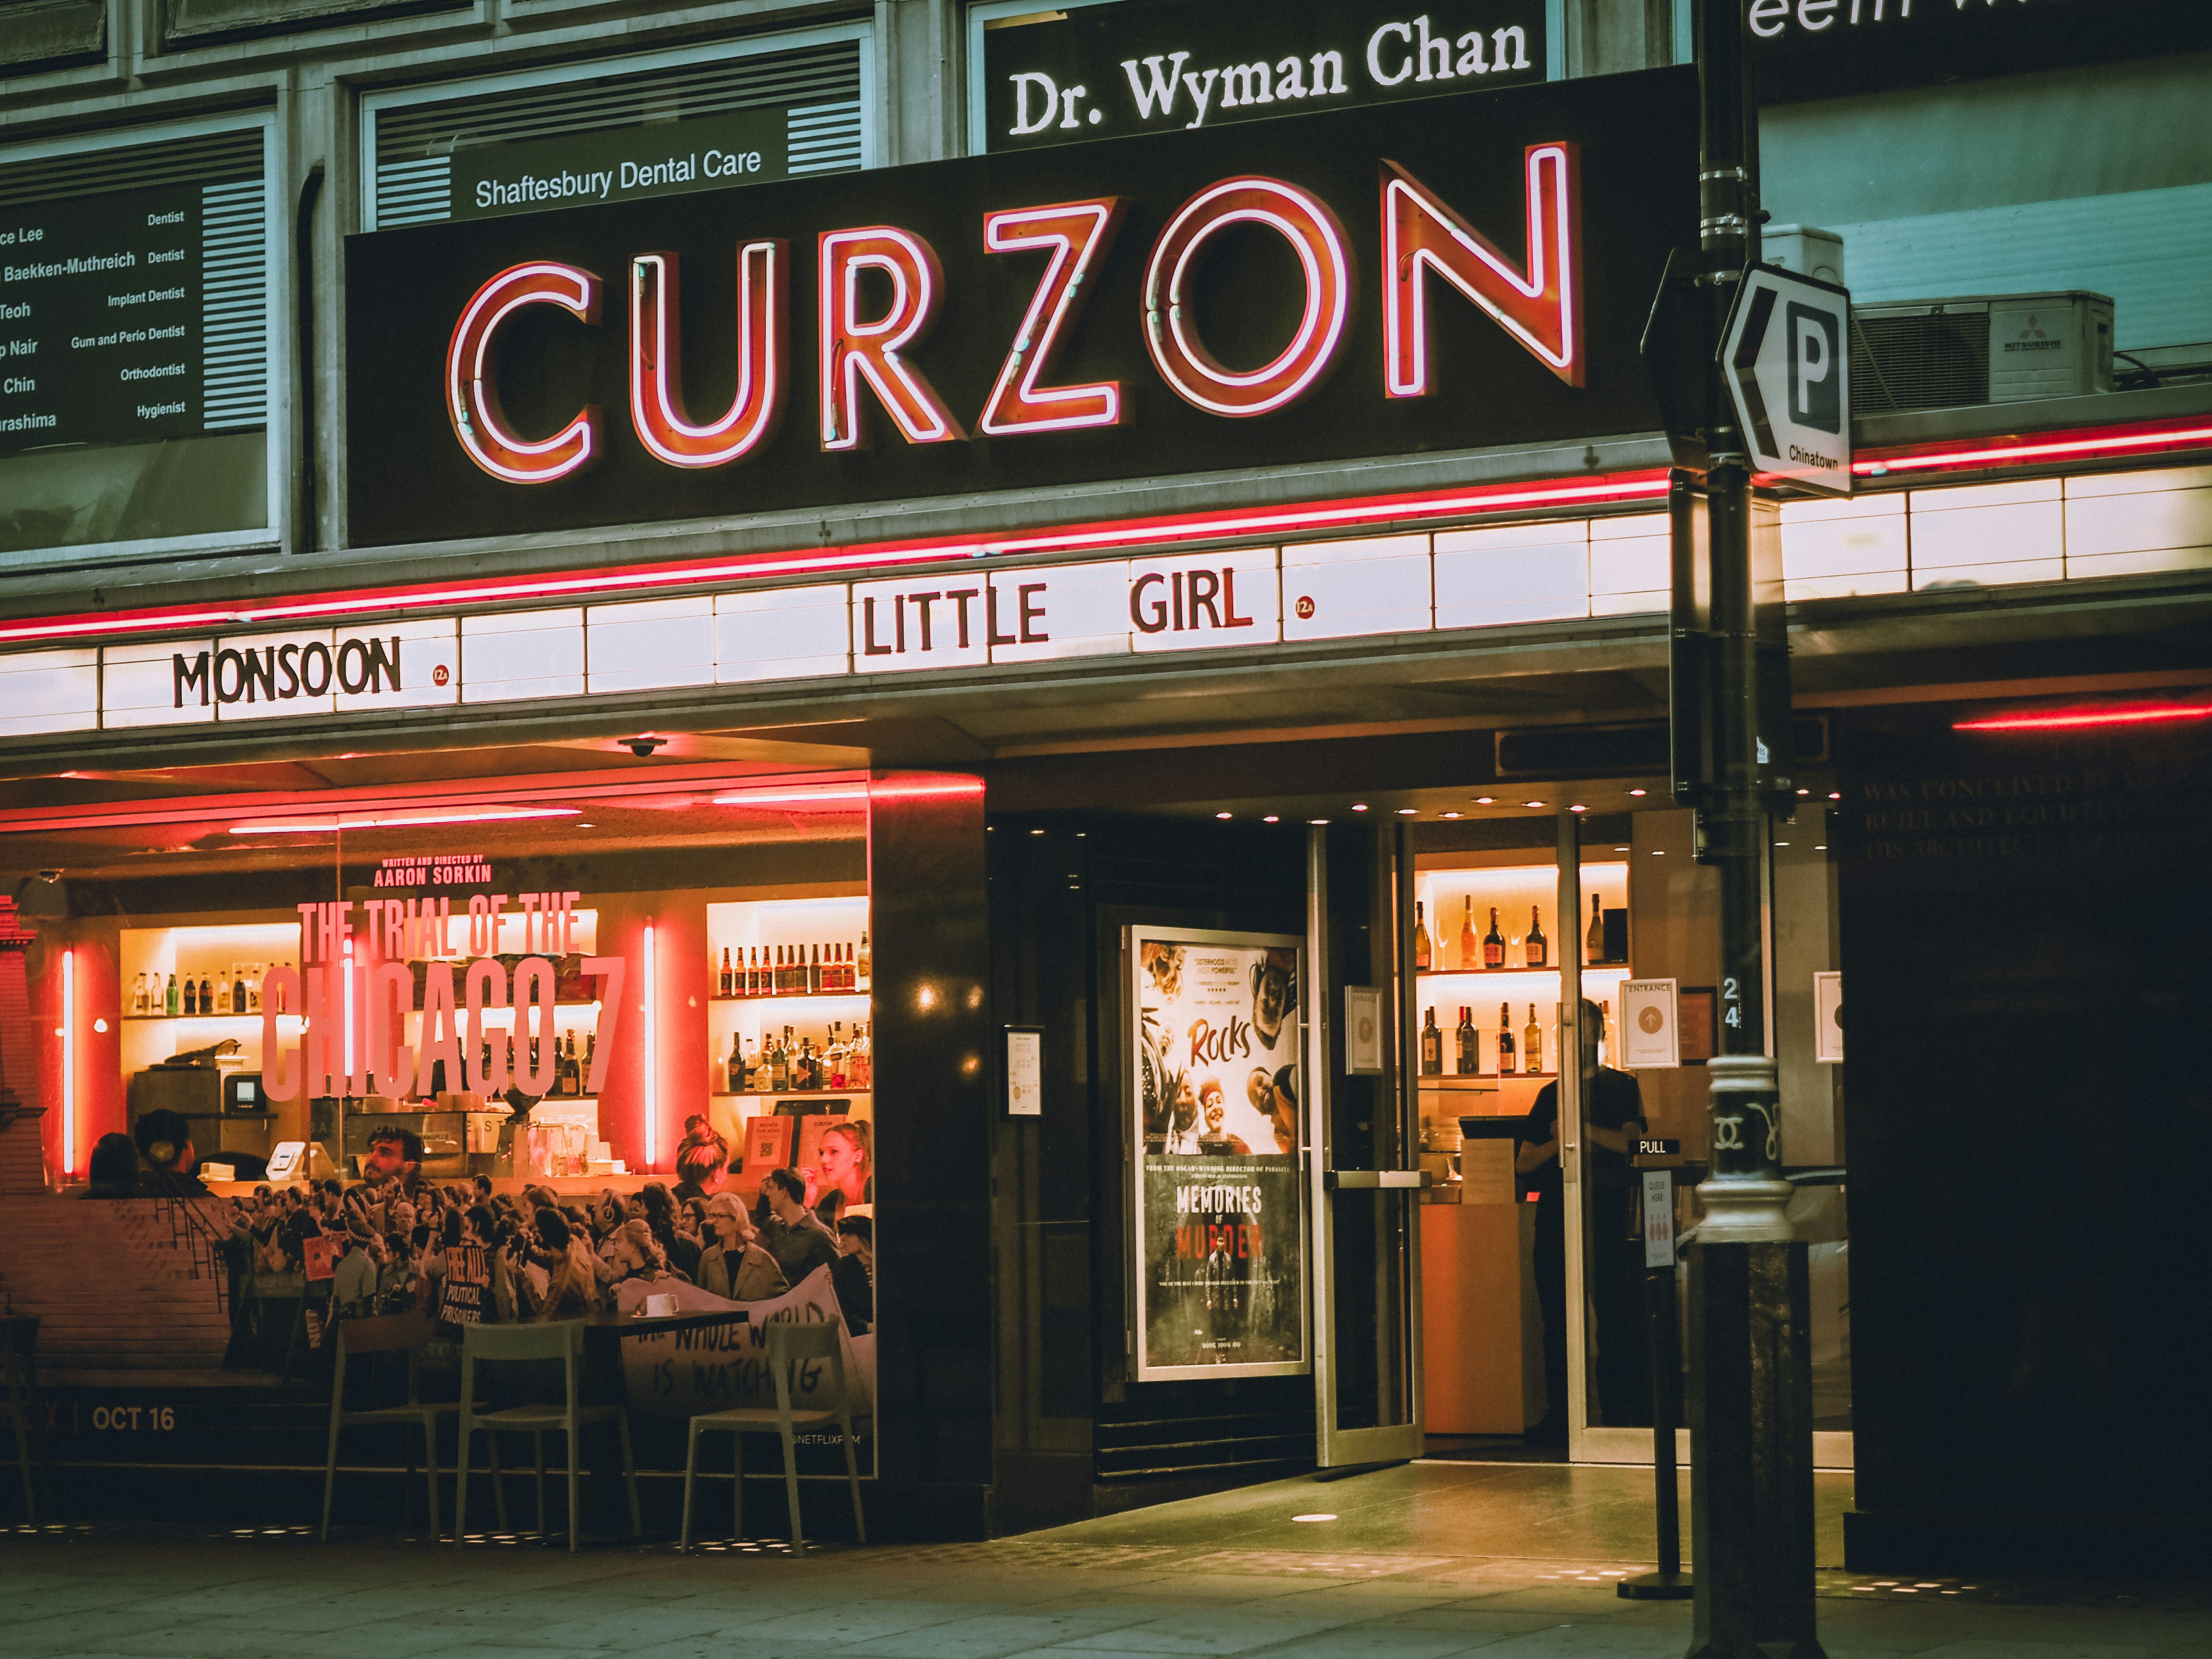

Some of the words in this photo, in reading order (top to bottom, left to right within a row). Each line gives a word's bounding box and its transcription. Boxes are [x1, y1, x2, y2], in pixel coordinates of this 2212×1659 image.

[1009, 71, 1101, 135] Dr.
[1120, 49, 1347, 130] Wyman
[1366, 15, 1530, 86] Chan
[476, 169, 613, 207] Shaftesbury
[620, 153, 696, 189] Dental
[703, 149, 761, 178] Care
[148, 211, 184, 226] Dentist
[19, 228, 43, 242] Lee
[4, 251, 135, 282] Baekken-Muthreich
[148, 249, 184, 264] Dentist
[108, 292, 146, 308] Implant
[149, 287, 184, 302] Dentist
[0, 302, 30, 319] Teoh
[446, 142, 1586, 485] CURZON
[10, 338, 37, 356] Nair
[72, 337, 95, 349] Gum
[97, 333, 117, 346] and
[120, 330, 145, 343] Perio
[149, 325, 185, 340] Dentist
[2004, 340, 2060, 349] MITSUBISHI
[120, 363, 185, 381] Orthodontist
[4, 376, 35, 394] Chin
[137, 401, 185, 418] Hygienist
[1789, 444, 1839, 472] Chinatown
[864, 583, 1048, 655] LITTLE
[1130, 567, 1253, 633] GIRL
[173, 636, 401, 708] MONSOON
[433, 667, 449, 684] 12A
[382, 857, 415, 867] WRITTEN
[417, 856, 432, 866] AND
[434, 855, 471, 865] DIRECTED
[473, 854, 483, 863] BY
[373, 867, 426, 887] AARON
[433, 865, 491, 885] SORKIN
[297, 901, 353, 962] THE
[364, 896, 457, 960] TRIAL
[469, 894, 508, 957] OF
[519, 891, 580, 953] THE
[1629, 984, 1671, 992] ENTRANCE
[262, 957, 556, 1102] CHICAGO
[580, 956, 625, 1093] 7
[1640, 1141, 1666, 1153] PULL
[1177, 1186, 1262, 1214] MEMORIES
[1215, 1214, 1222, 1224] OF
[446, 1285, 480, 1305] POLITICAL
[93, 1407, 142, 1430] OCT
[149, 1407, 174, 1430] 16
